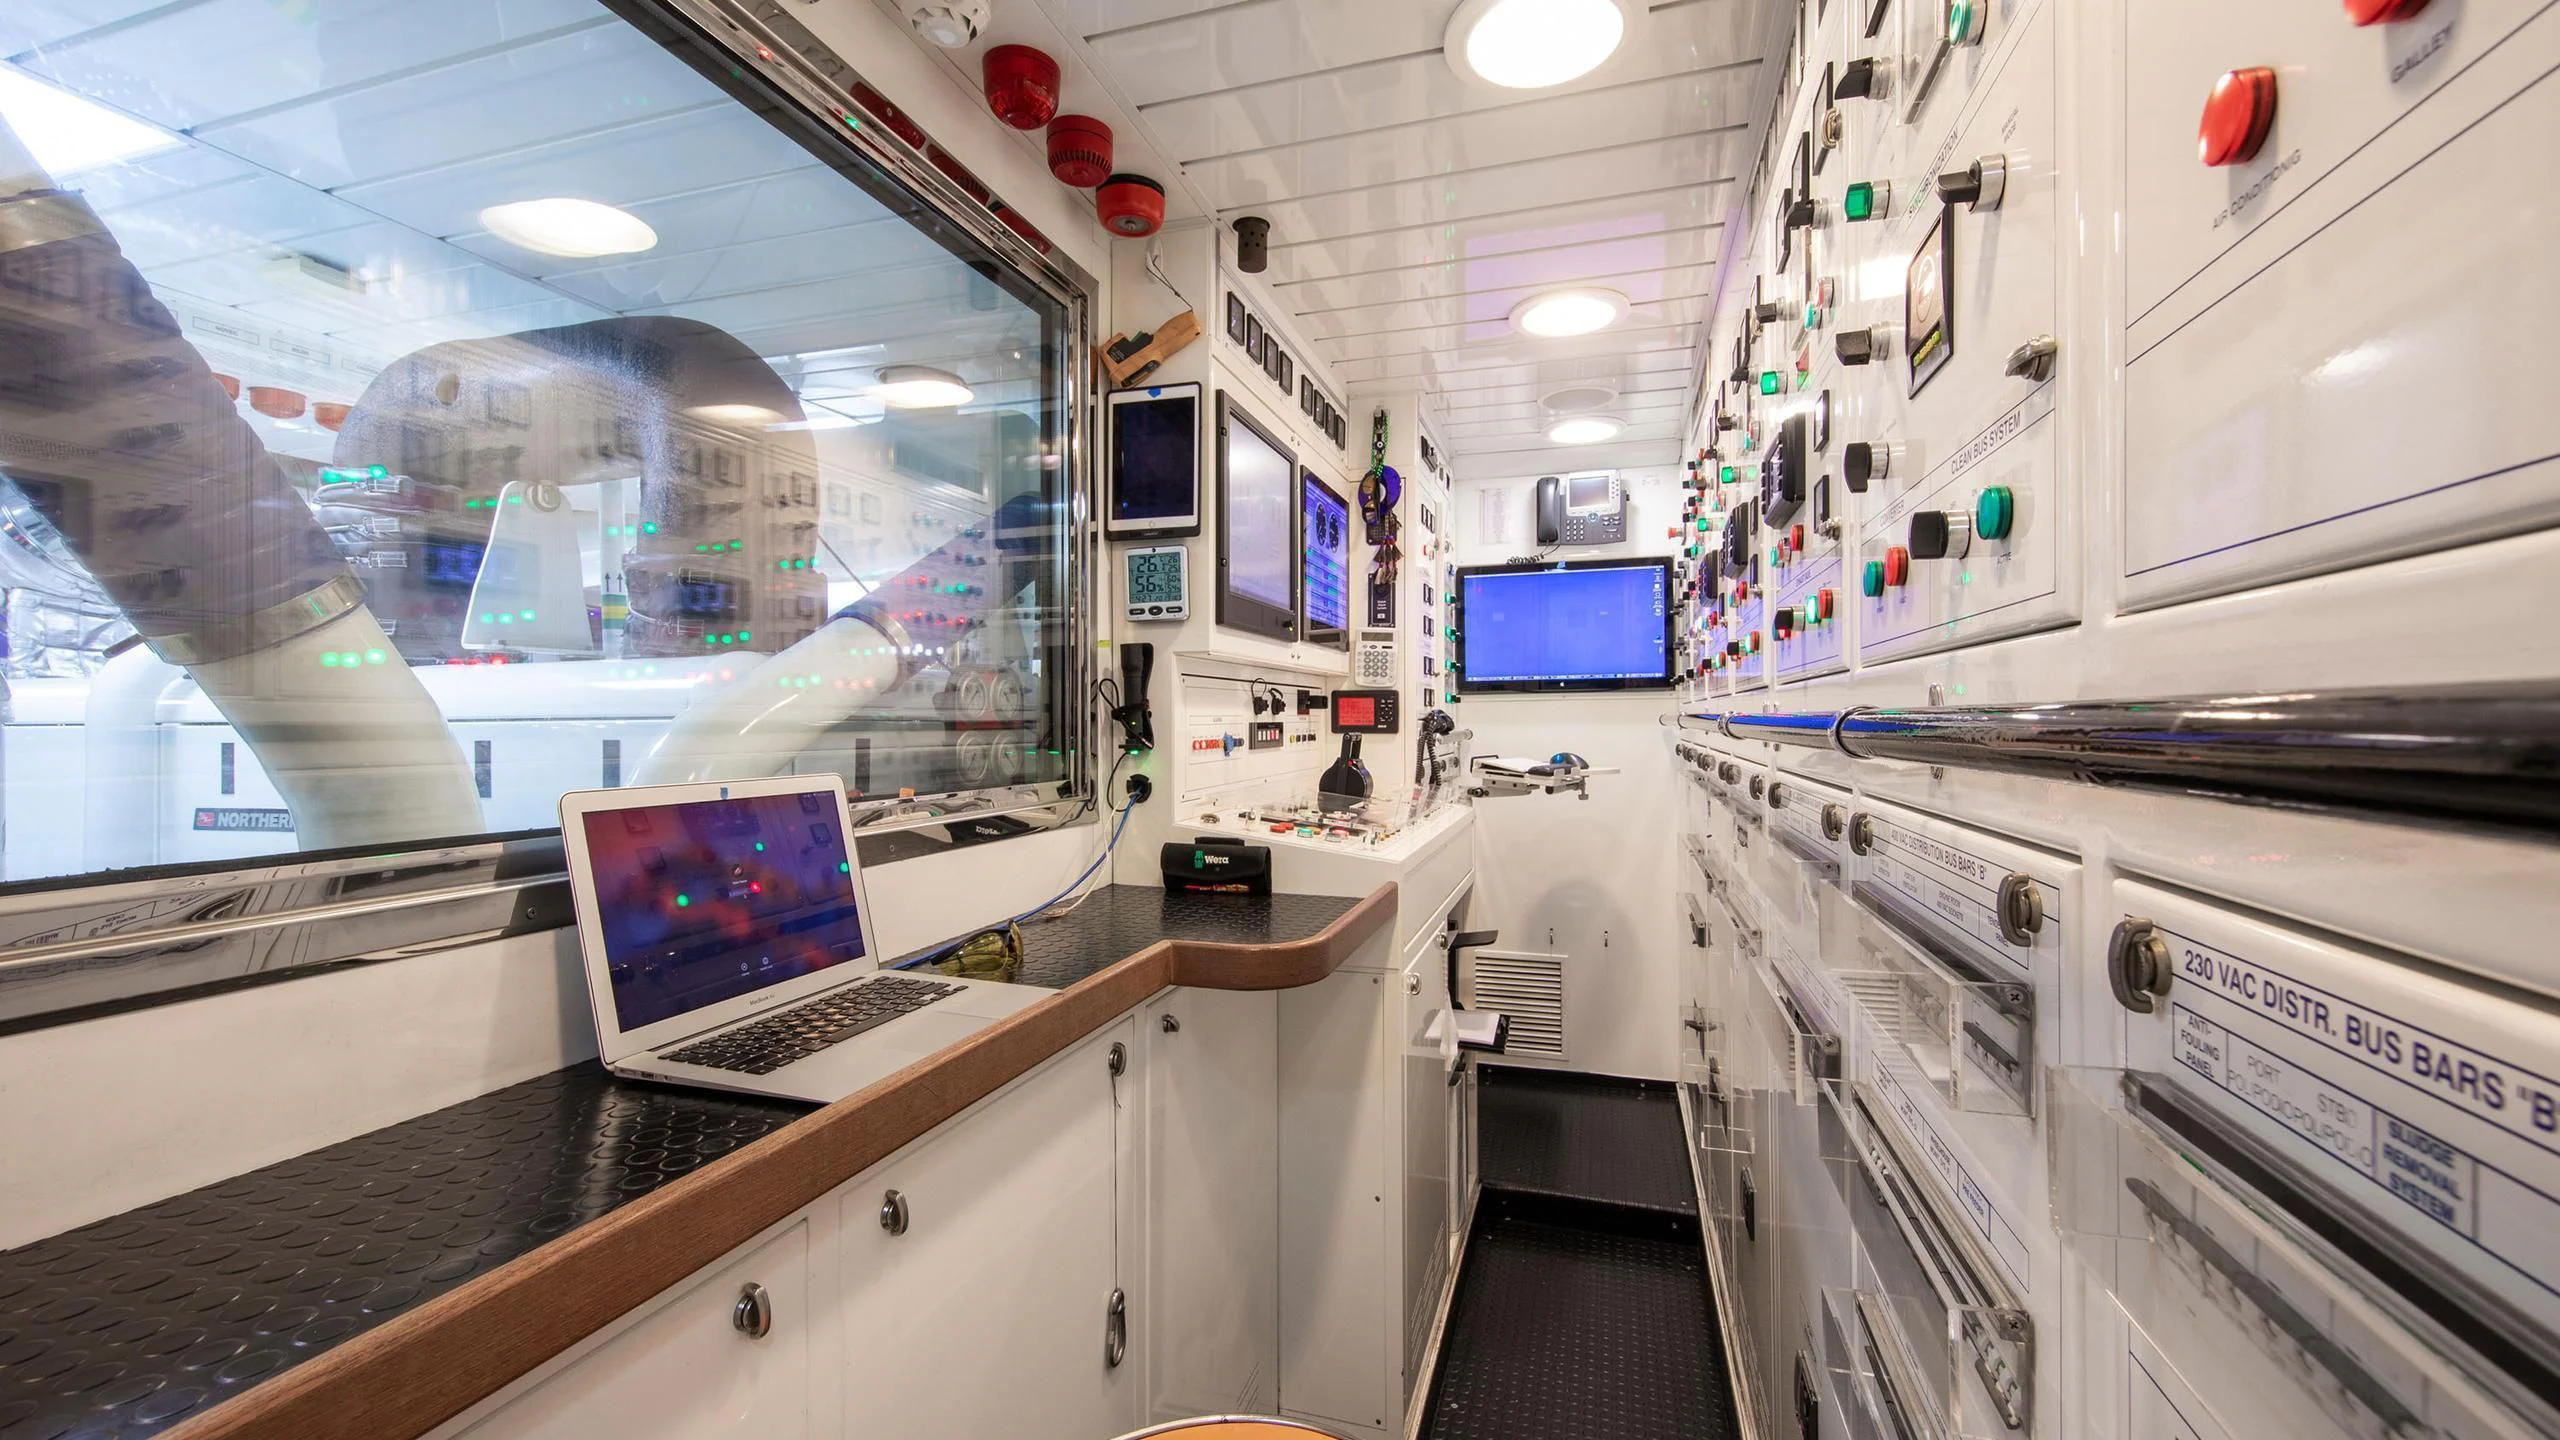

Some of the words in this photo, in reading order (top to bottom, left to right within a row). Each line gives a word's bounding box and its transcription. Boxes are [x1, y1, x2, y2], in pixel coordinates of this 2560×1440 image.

[1951, 453, 1972, 476] CLEAN
[1973, 437, 1988, 459] BUS
[1989, 411, 2021, 448] SYSTEM
[1204, 855, 1229, 864] Wera
[1909, 836, 1944, 864] DISTRIBUTION
[1944, 851, 1957, 868] BUS
[1958, 855, 1977, 877] BARS
[2180, 1028, 2220, 1061] FOULING
[2185, 950, 2213, 981] 230
[2219, 961, 2257, 1000] VAC
[2263, 980, 2338, 1037] DISTR.
[2346, 1013, 2402, 1065] BUS
[2412, 1041, 2505, 1110] BARS
[2188, 1014, 2212, 1035] ANTI-
[2186, 1051, 2214, 1078] PANEL
[2247, 1055, 2280, 1084] PORT
[2389, 1120, 2455, 1169] SLUDGE
[2383, 1142, 2464, 1201] REMOVAL
[2389, 1171, 2454, 1223] SYSTEM
